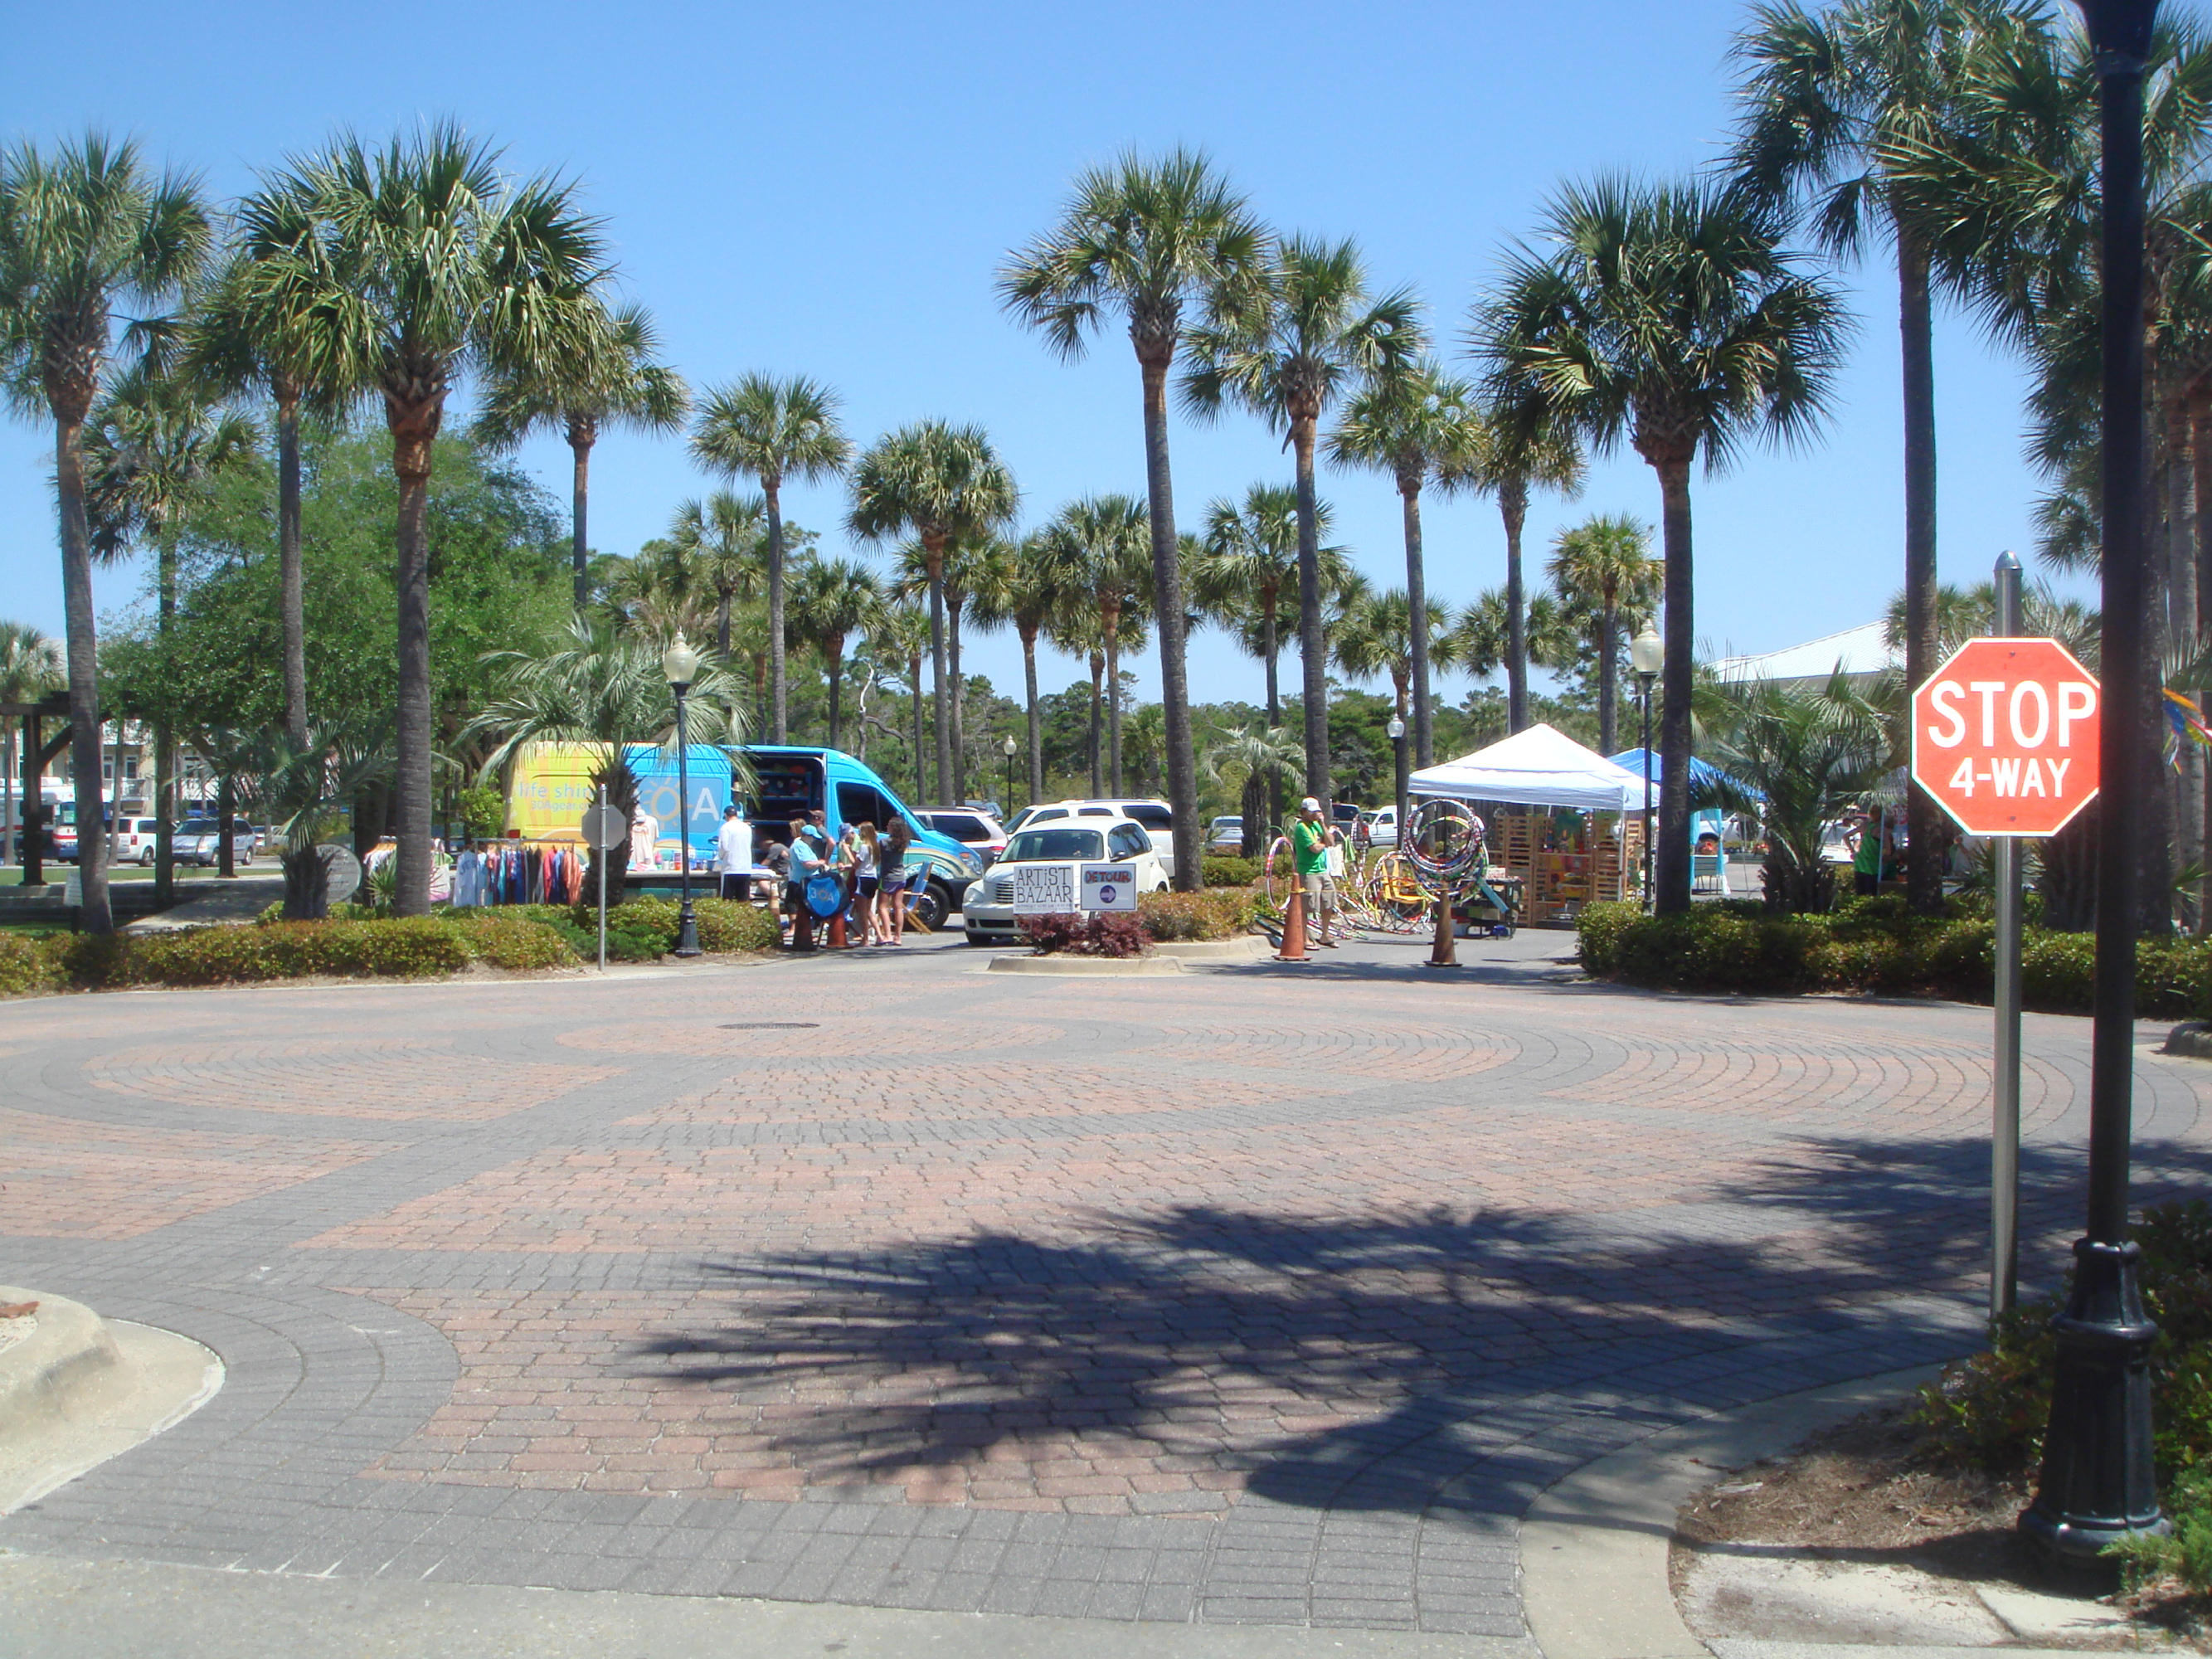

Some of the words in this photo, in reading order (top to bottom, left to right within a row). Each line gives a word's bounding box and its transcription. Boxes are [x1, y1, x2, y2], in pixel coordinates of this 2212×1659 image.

[1928, 680, 2097, 748] STOP
[1949, 757, 2071, 797] 4-WAY
[519, 782, 547, 797] life
[555, 783, 593, 798] shin
[1084, 869, 1131, 884] DETOUR
[1016, 885, 1072, 903] BAZAAR
